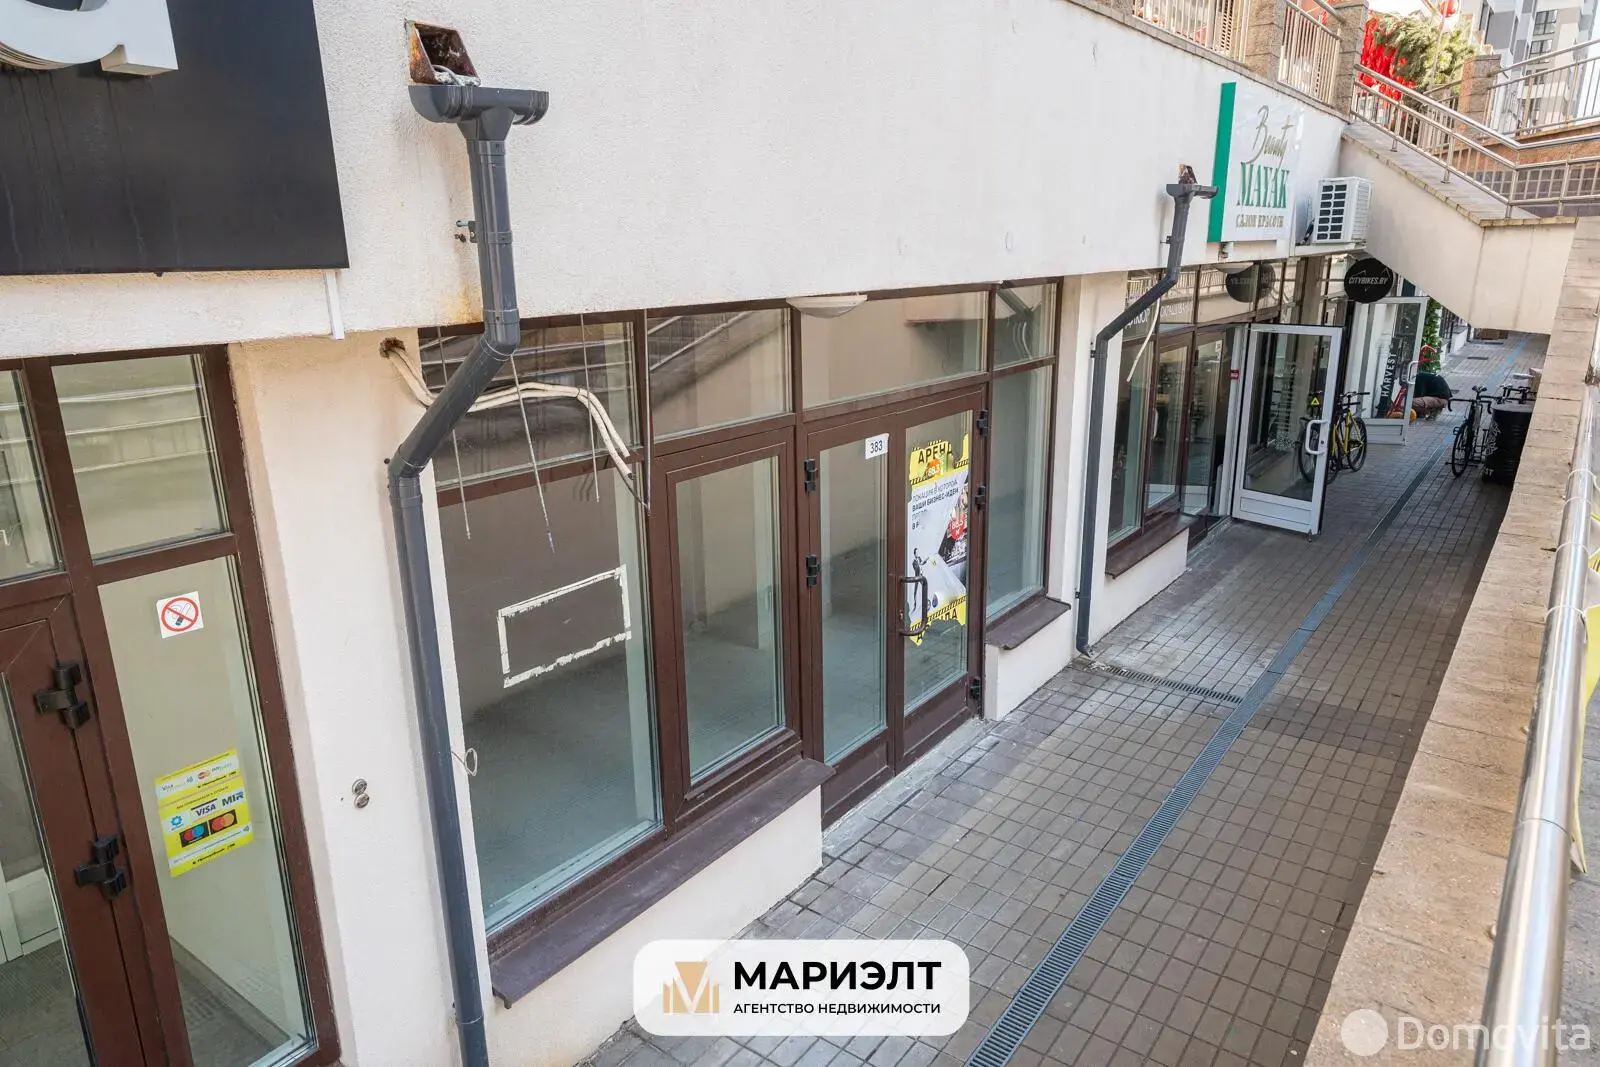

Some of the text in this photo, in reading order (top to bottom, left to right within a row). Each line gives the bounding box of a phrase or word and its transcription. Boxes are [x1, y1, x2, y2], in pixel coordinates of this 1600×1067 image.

[1348, 276, 1388, 285] CITYBIKES.BY
[1380, 352, 1397, 397] HARVEST
[870, 440, 883, 454] 383
[912, 487, 959, 512] ВАШИ БИЗНЕС-ИДЕИ
[195, 803, 216, 817] VISA
[221, 791, 244, 807] MIR
